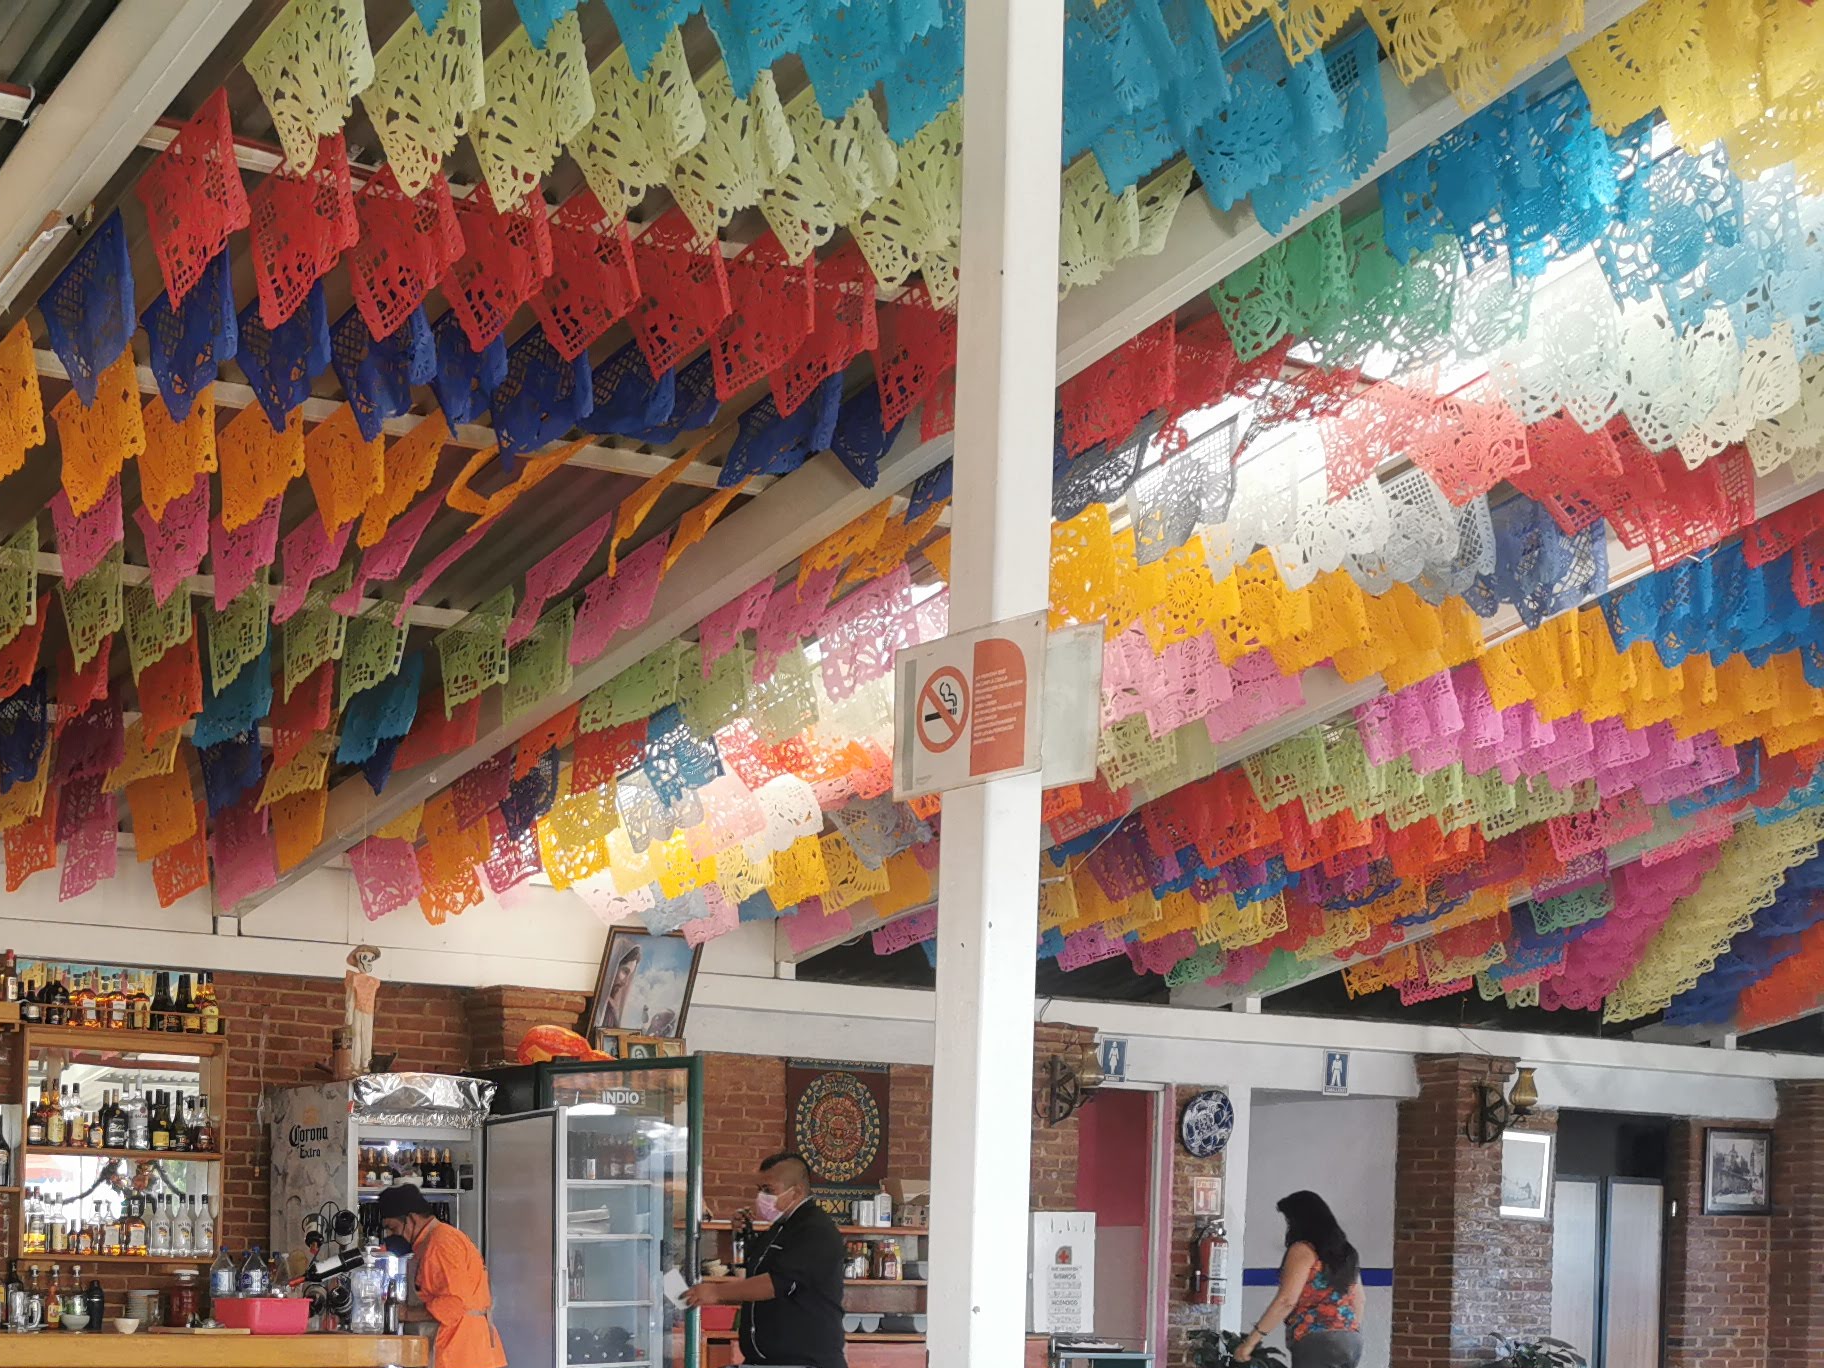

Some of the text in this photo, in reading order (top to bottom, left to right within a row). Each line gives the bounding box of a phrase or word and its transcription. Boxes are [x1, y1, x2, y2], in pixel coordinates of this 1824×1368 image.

[602, 1091, 639, 1104] INDIO
[289, 1125, 328, 1148] Corona
[300, 1145, 321, 1159] Extra
